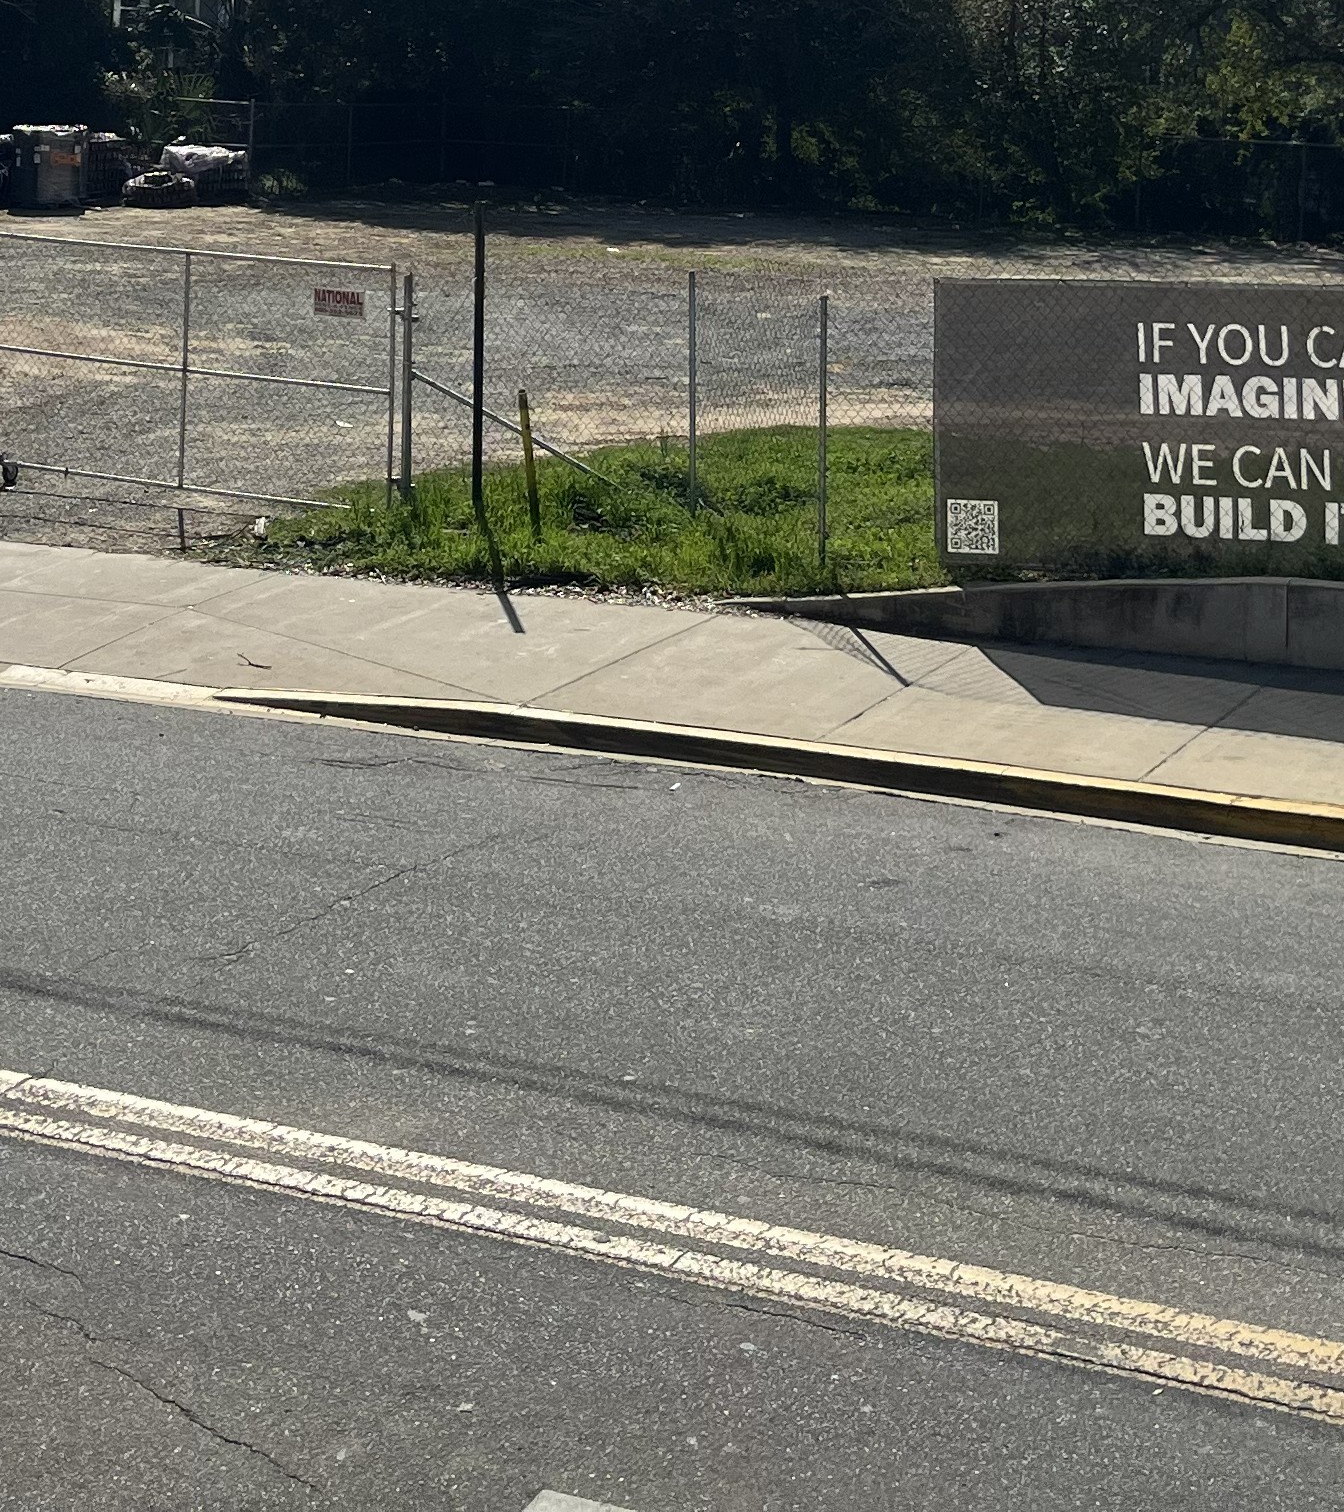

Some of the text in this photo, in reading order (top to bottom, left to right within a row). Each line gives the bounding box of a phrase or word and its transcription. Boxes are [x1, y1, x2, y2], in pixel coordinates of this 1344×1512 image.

[314, 287, 364, 305] NATIONAL
[1137, 322, 1175, 363] IF
[1187, 323, 1289, 367] YOU
[1142, 441, 1331, 491] WE CAN
[1143, 493, 1307, 542] BUILD
